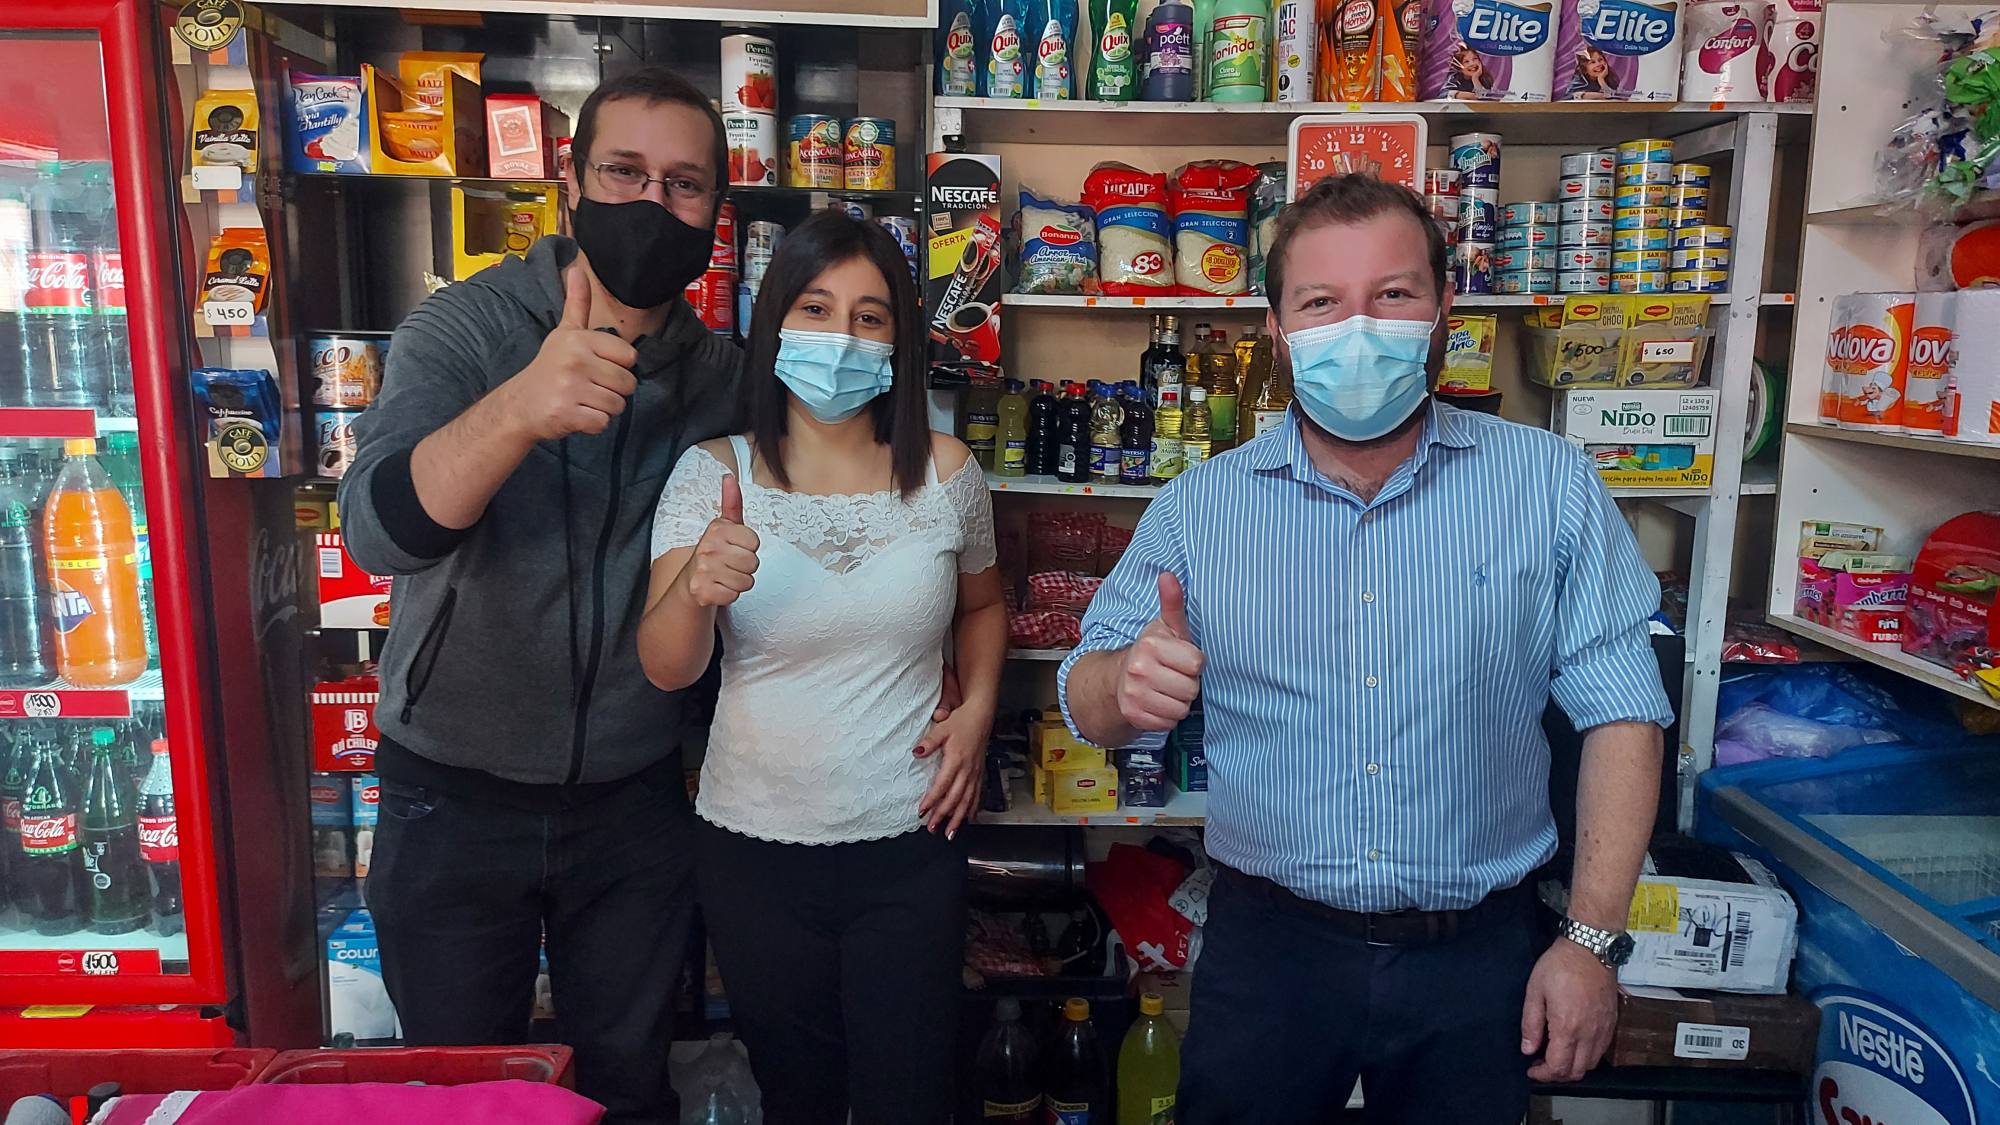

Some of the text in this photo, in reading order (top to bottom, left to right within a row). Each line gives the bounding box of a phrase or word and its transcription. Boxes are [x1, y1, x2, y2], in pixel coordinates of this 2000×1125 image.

[182, 22, 234, 43] GOLD
[1468, 8, 1542, 44] Elite
[1594, 9, 1668, 43] Elite
[947, 32, 973, 50] Quix
[993, 32, 1019, 53] Quix
[1102, 32, 1129, 52] Quix
[1159, 32, 1190, 47] poett
[1703, 34, 1754, 50] Confort
[1039, 38, 1065, 58] Quix
[1520, 92, 1529, 101] 4
[1647, 91, 1655, 100] 4
[1349, 133, 1365, 145] 12
[1326, 141, 1341, 152] 11
[1381, 141, 1388, 152] 1
[1309, 159, 1325, 170] 10
[1394, 157, 1403, 168] 2
[1103, 214, 1121, 224] GRAN
[1041, 231, 1080, 240] Bonanza
[1228, 231, 1234, 239] 2
[932, 234, 967, 250] OFERTA
[216, 308, 248, 320] 450
[1450, 330, 1469, 342] opa
[1575, 343, 1604, 357] 500
[1655, 347, 1674, 356] 650
[1162, 372, 1179, 383] Chef
[1600, 410, 1656, 427] NIDO
[226, 451, 262, 467] GOLD
[1680, 473, 1708, 481] NIDO
[30, 693, 56, 709] 1500
[1838, 1010, 1926, 1085] Nestlé
